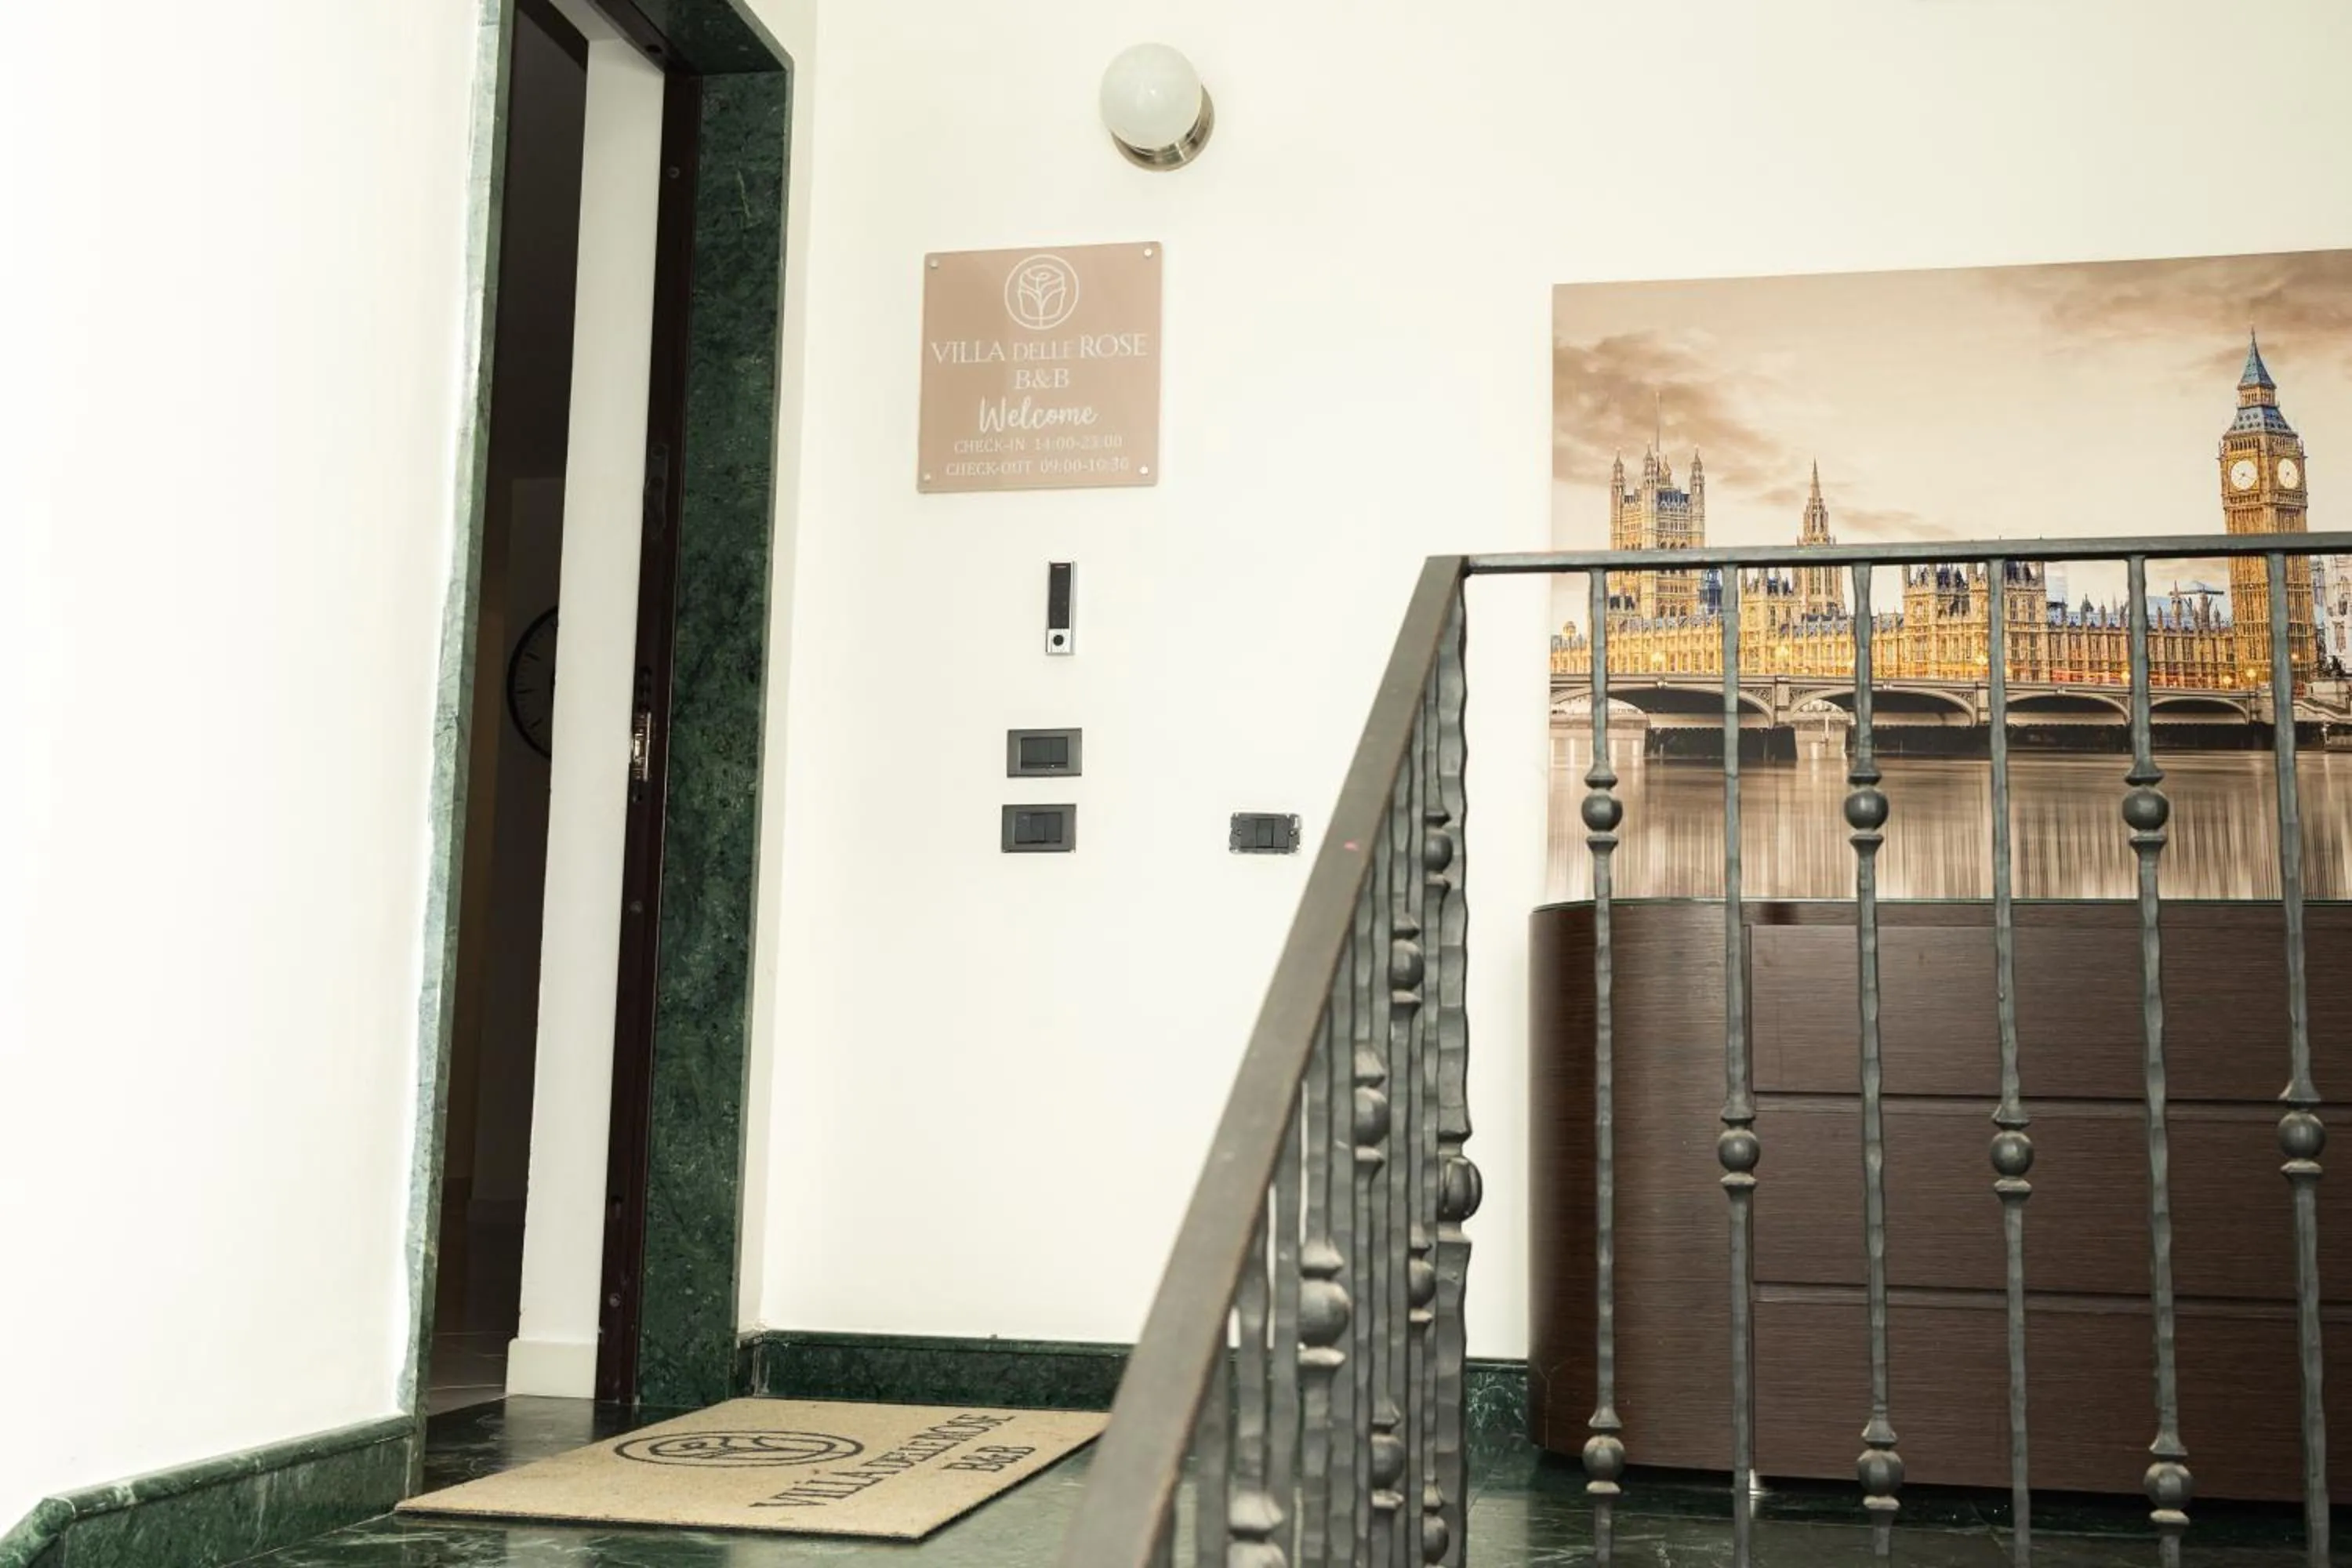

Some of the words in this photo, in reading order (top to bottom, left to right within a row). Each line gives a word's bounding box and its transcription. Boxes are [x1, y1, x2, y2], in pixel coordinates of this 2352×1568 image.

[931, 340, 1005, 363] VILLA
[1013, 341, 1072, 361] DELLE
[1080, 332, 1149, 359] ROSE
[1015, 368, 1070, 390] B&B
[980, 395, 1098, 432] Welcome
[954, 437, 1025, 452] CHECK-IN
[946, 460, 1033, 476] CHECK-OUT
[909, 1414, 1017, 1442] ROSE
[861, 1440, 961, 1468] DELLE
[941, 1446, 1036, 1472] B&B
[749, 1470, 900, 1507] VILLA
